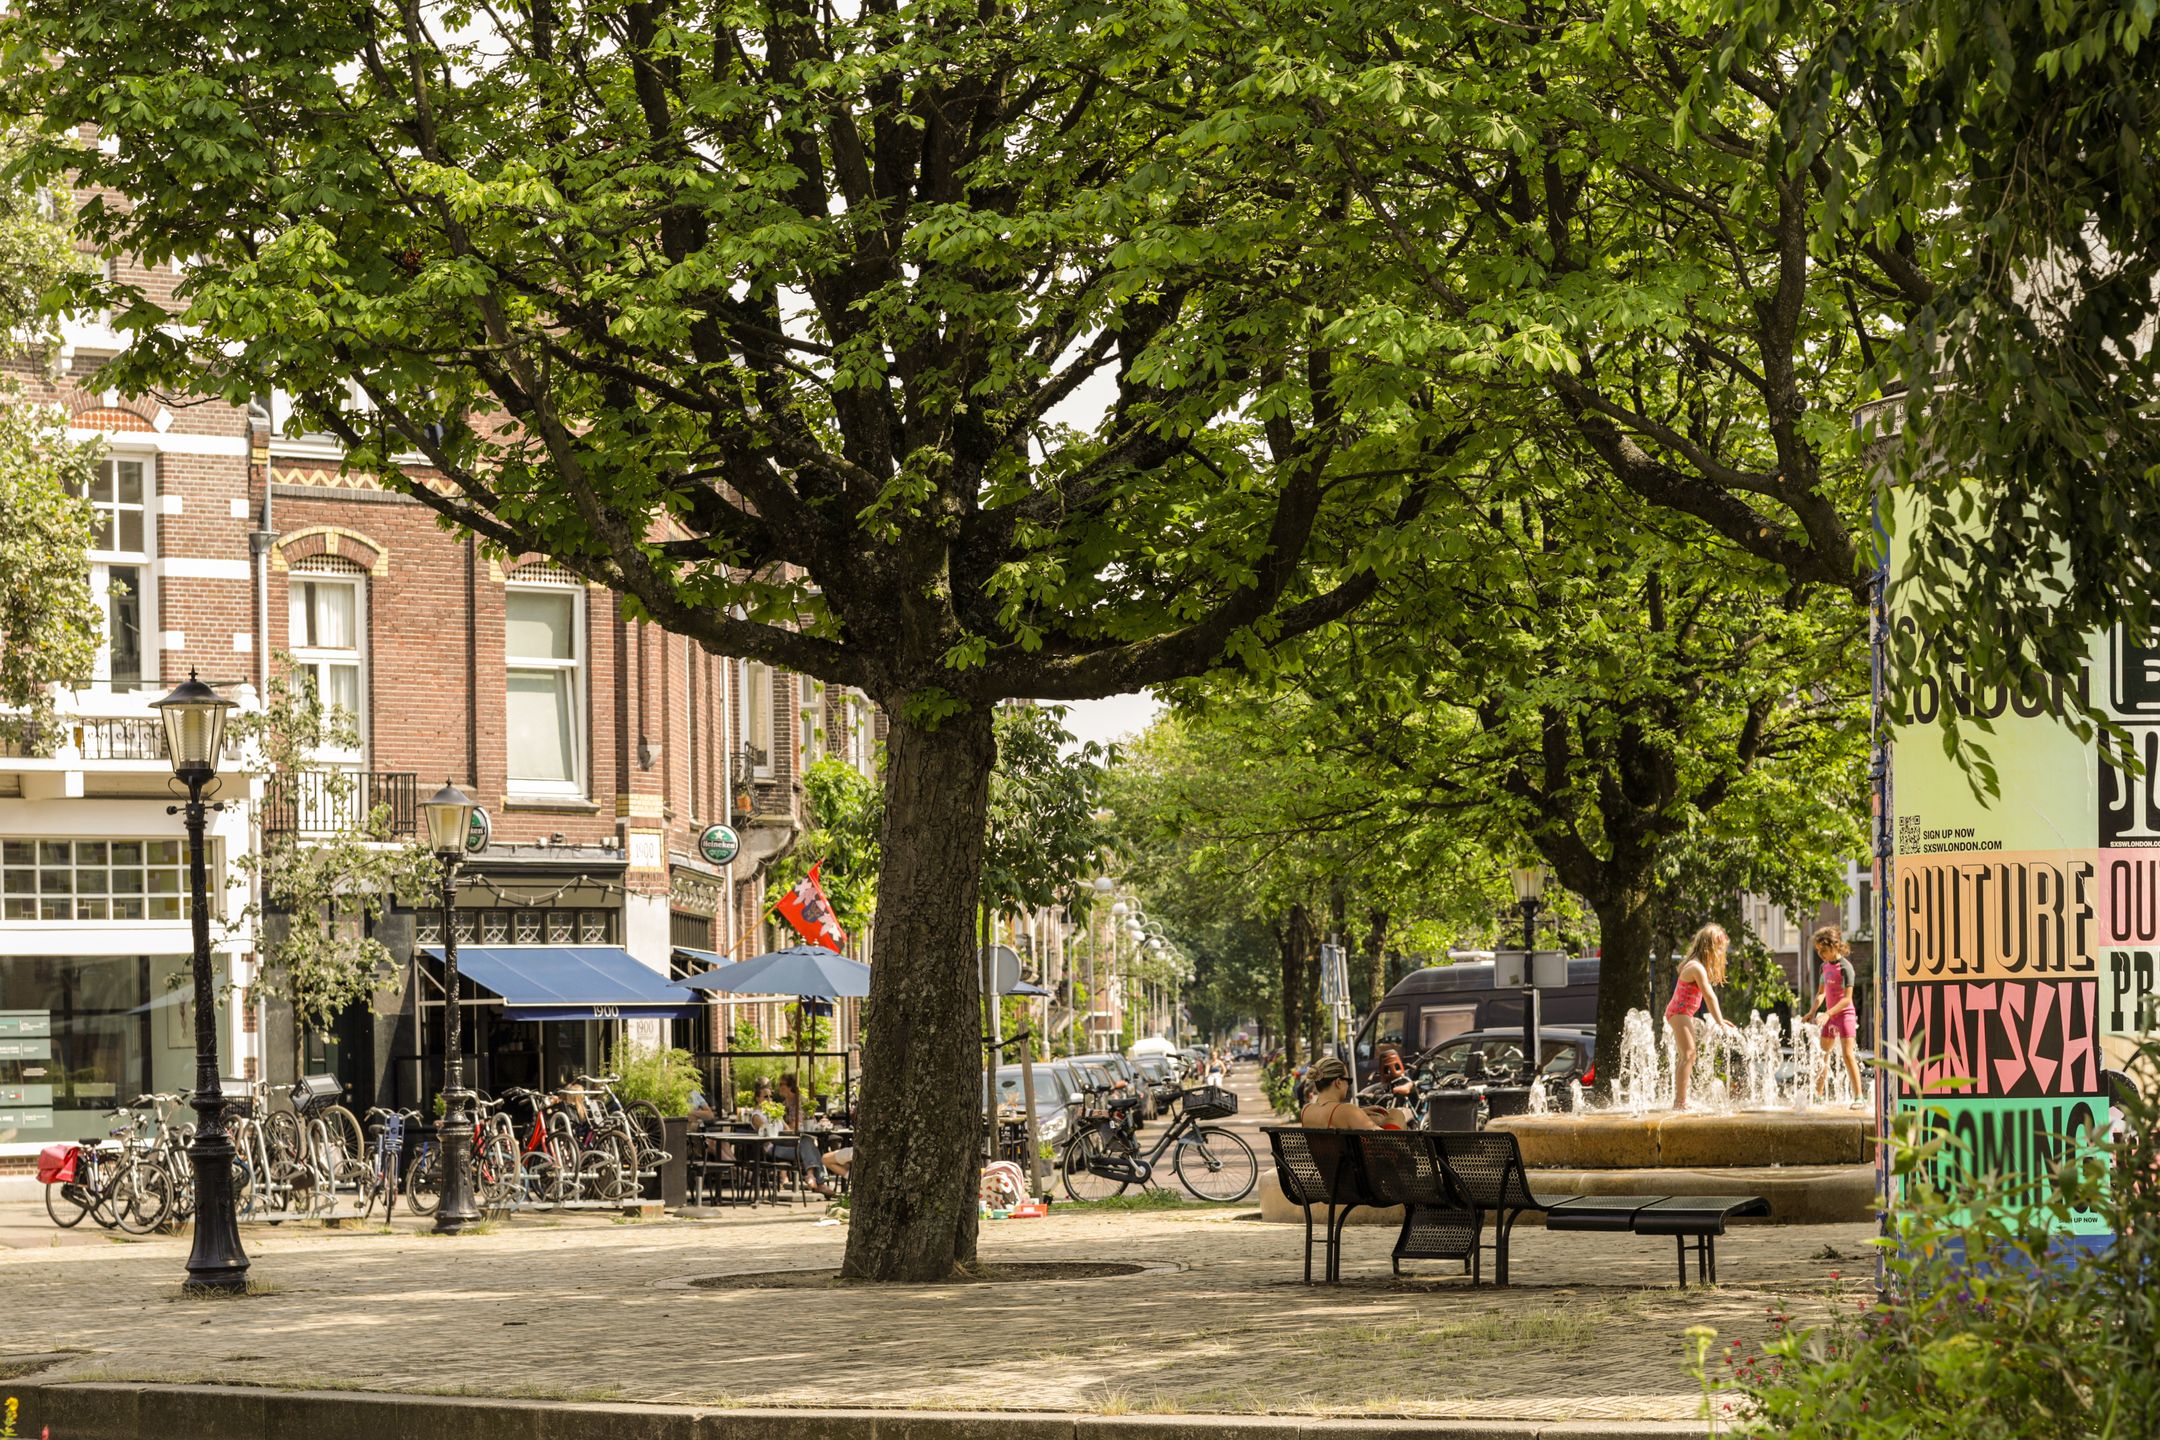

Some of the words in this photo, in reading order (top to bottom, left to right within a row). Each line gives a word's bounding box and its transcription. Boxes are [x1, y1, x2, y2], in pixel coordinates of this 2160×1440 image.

[1923, 829, 1941, 841] SIGN
[1941, 829, 1953, 839] UP
[1954, 828, 1975, 838] NOW
[635, 842, 654, 858] 1900
[702, 840, 736, 849] Heineken
[1923, 841, 2002, 853] SXSWLONDON.COM
[2111, 860, 2160, 941] OU
[1901, 861, 2095, 976] CULTURE
[2111, 951, 2160, 1032] PR
[593, 1005, 619, 1018] 1900
[636, 1020, 654, 1034] 1900
[1901, 981, 2098, 1095] KLATSCH
